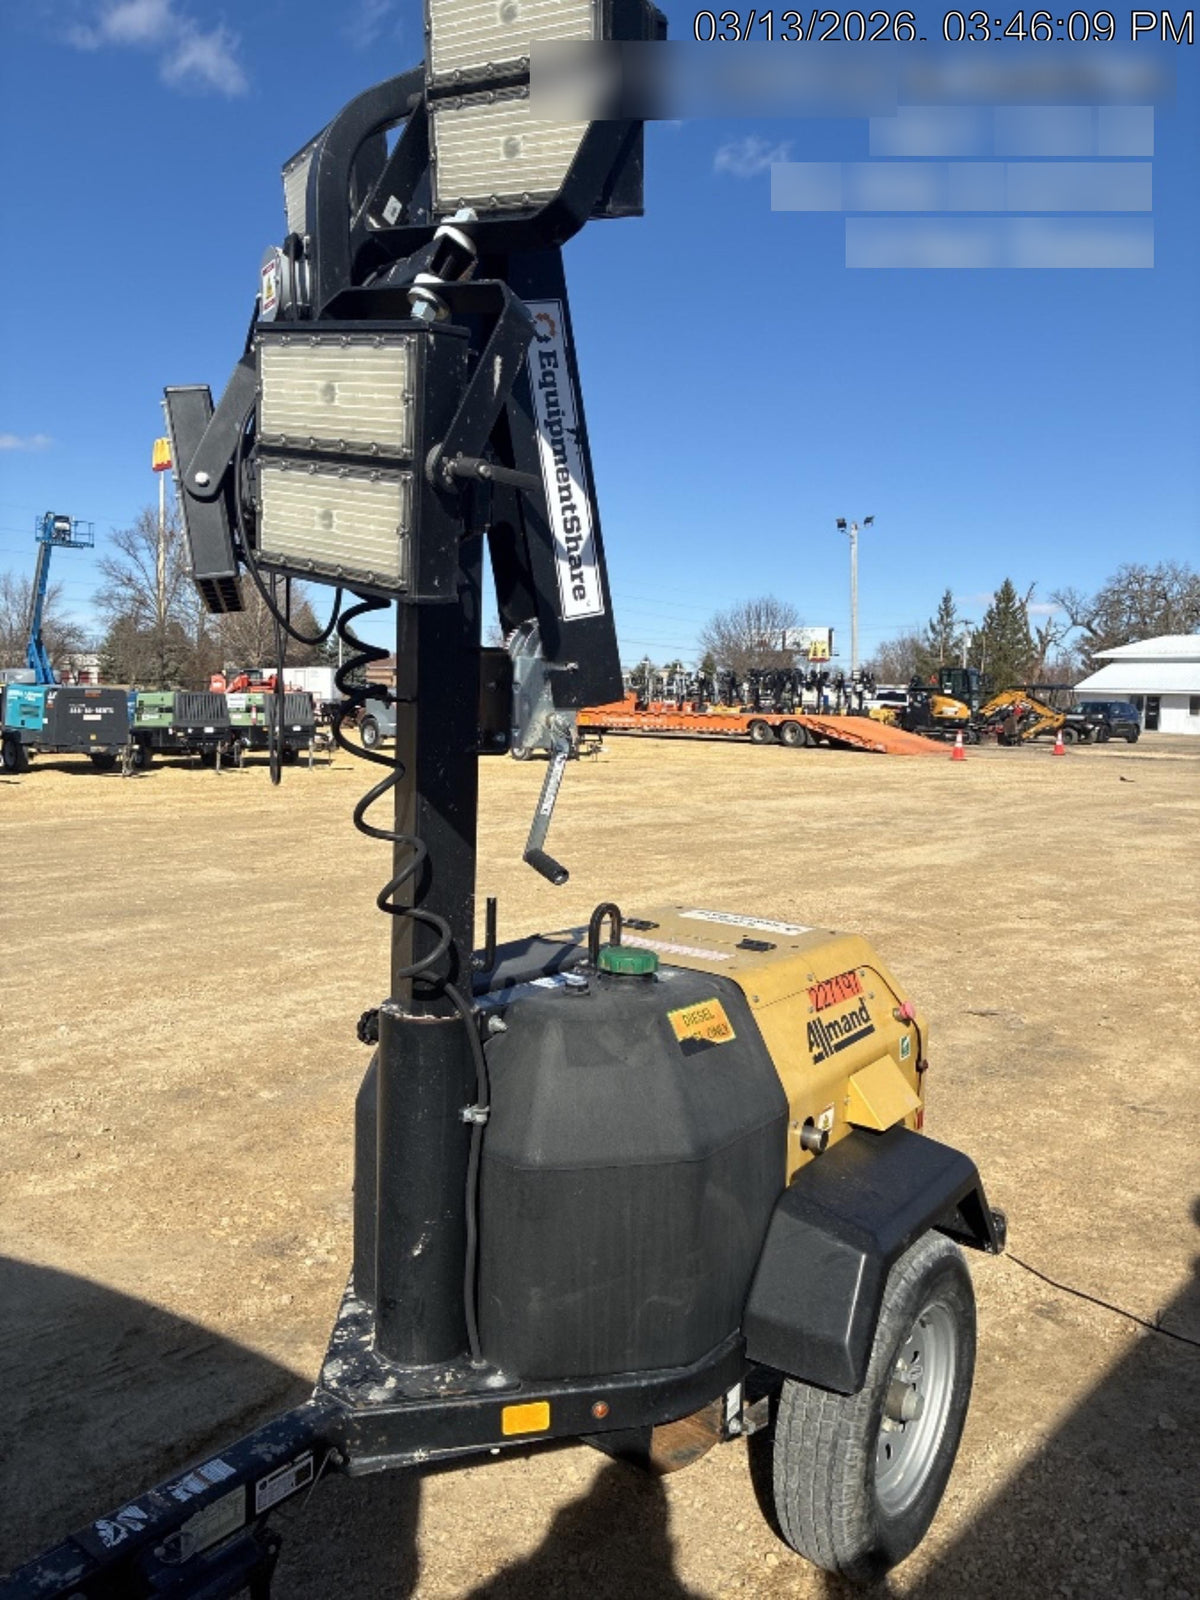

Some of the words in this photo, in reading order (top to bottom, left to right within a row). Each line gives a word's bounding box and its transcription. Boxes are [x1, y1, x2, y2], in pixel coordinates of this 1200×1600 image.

[538, 350, 586, 601] EquipmentShare
[682, 1007, 716, 1028] DIESEL
[806, 996, 872, 1058] Allmand
